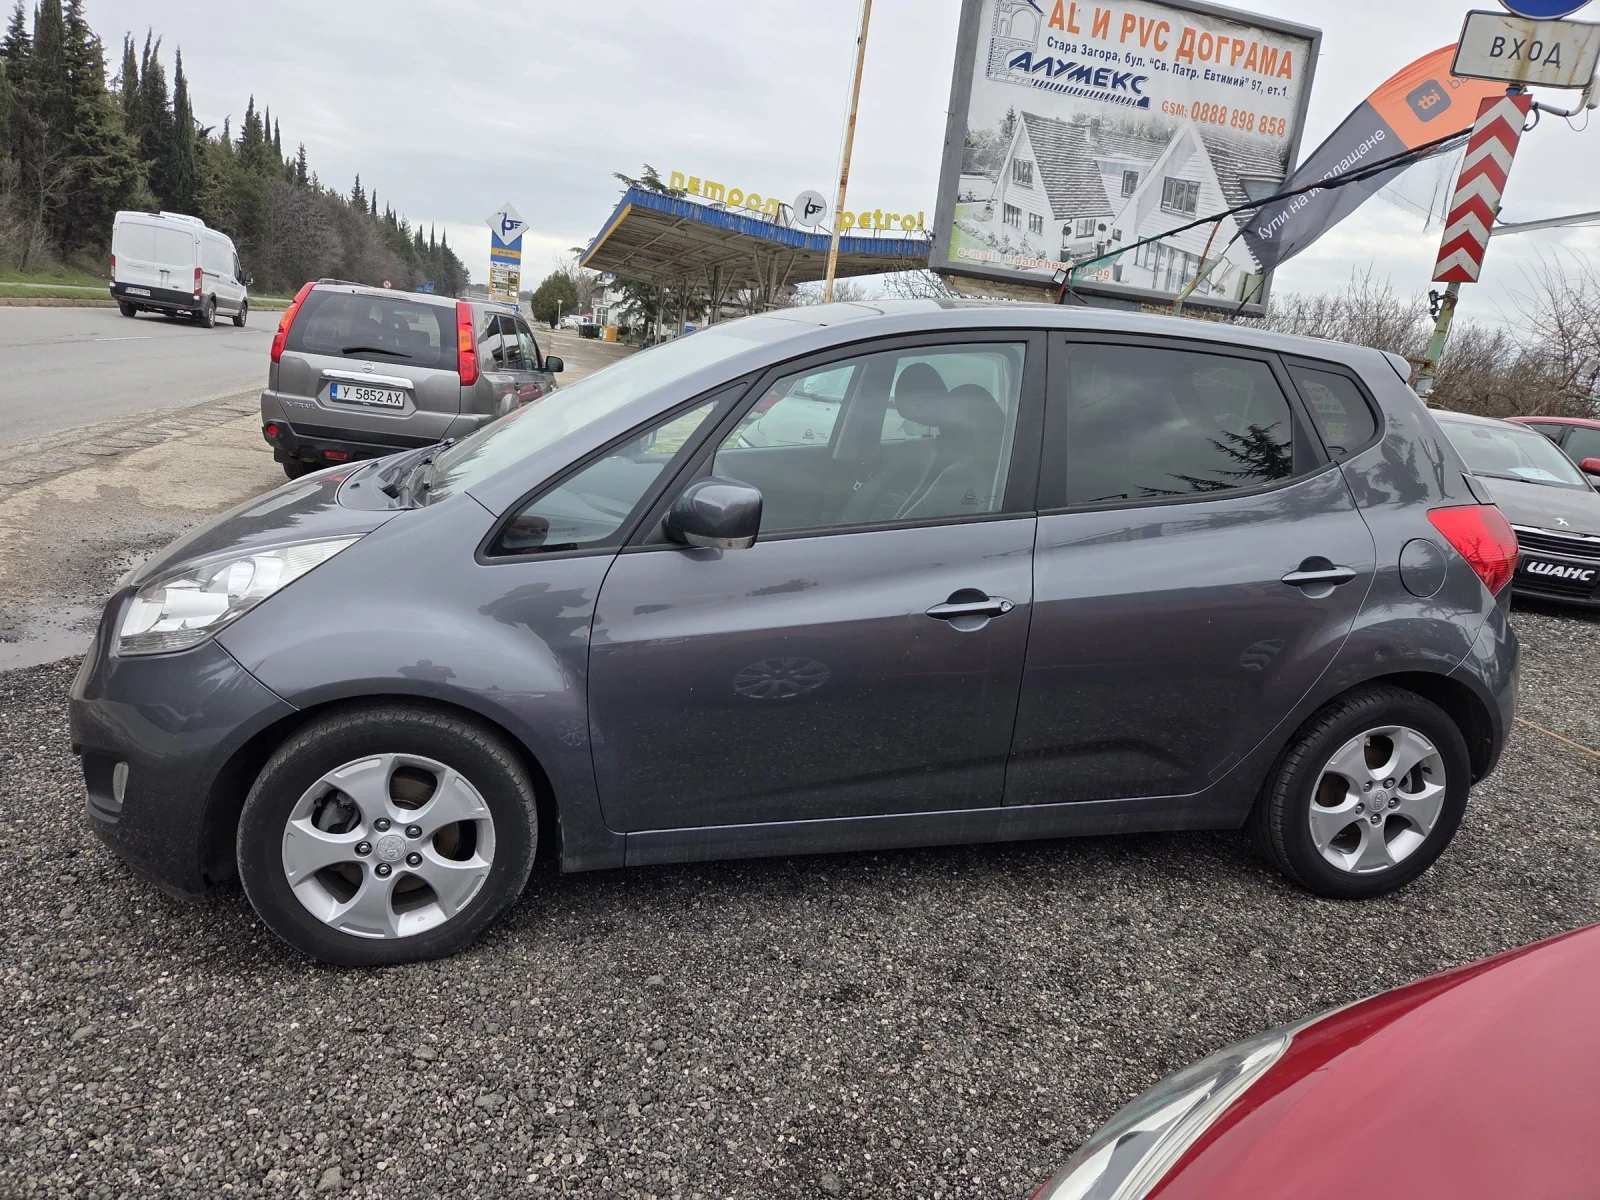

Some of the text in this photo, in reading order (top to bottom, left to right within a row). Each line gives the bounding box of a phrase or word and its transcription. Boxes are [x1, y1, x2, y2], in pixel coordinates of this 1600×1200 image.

[1048, 0, 1293, 80] AL И PVC ДОГРАМА
[1489, 35, 1562, 69] ВХОД
[1008, 50, 1151, 95] АЛУМЕКС
[1047, 36, 1077, 55] Стара
[1081, 43, 1121, 64] Загора,
[1124, 52, 1146, 68] бул.
[1172, 62, 1200, 80] Патр.
[1251, 80, 1264, 96] 97,
[1267, 86, 1287, 97] ет.1
[1417, 89, 1441, 110] tbi
[1161, 100, 1286, 136] GSM: 0888 898 858
[1290, 194, 1309, 214] на
[1309, 129, 1386, 198] иплащане
[840, 208, 924, 232] petrol
[355, 388, 384, 403] 5852
[1526, 561, 1596, 581] ШАНС
